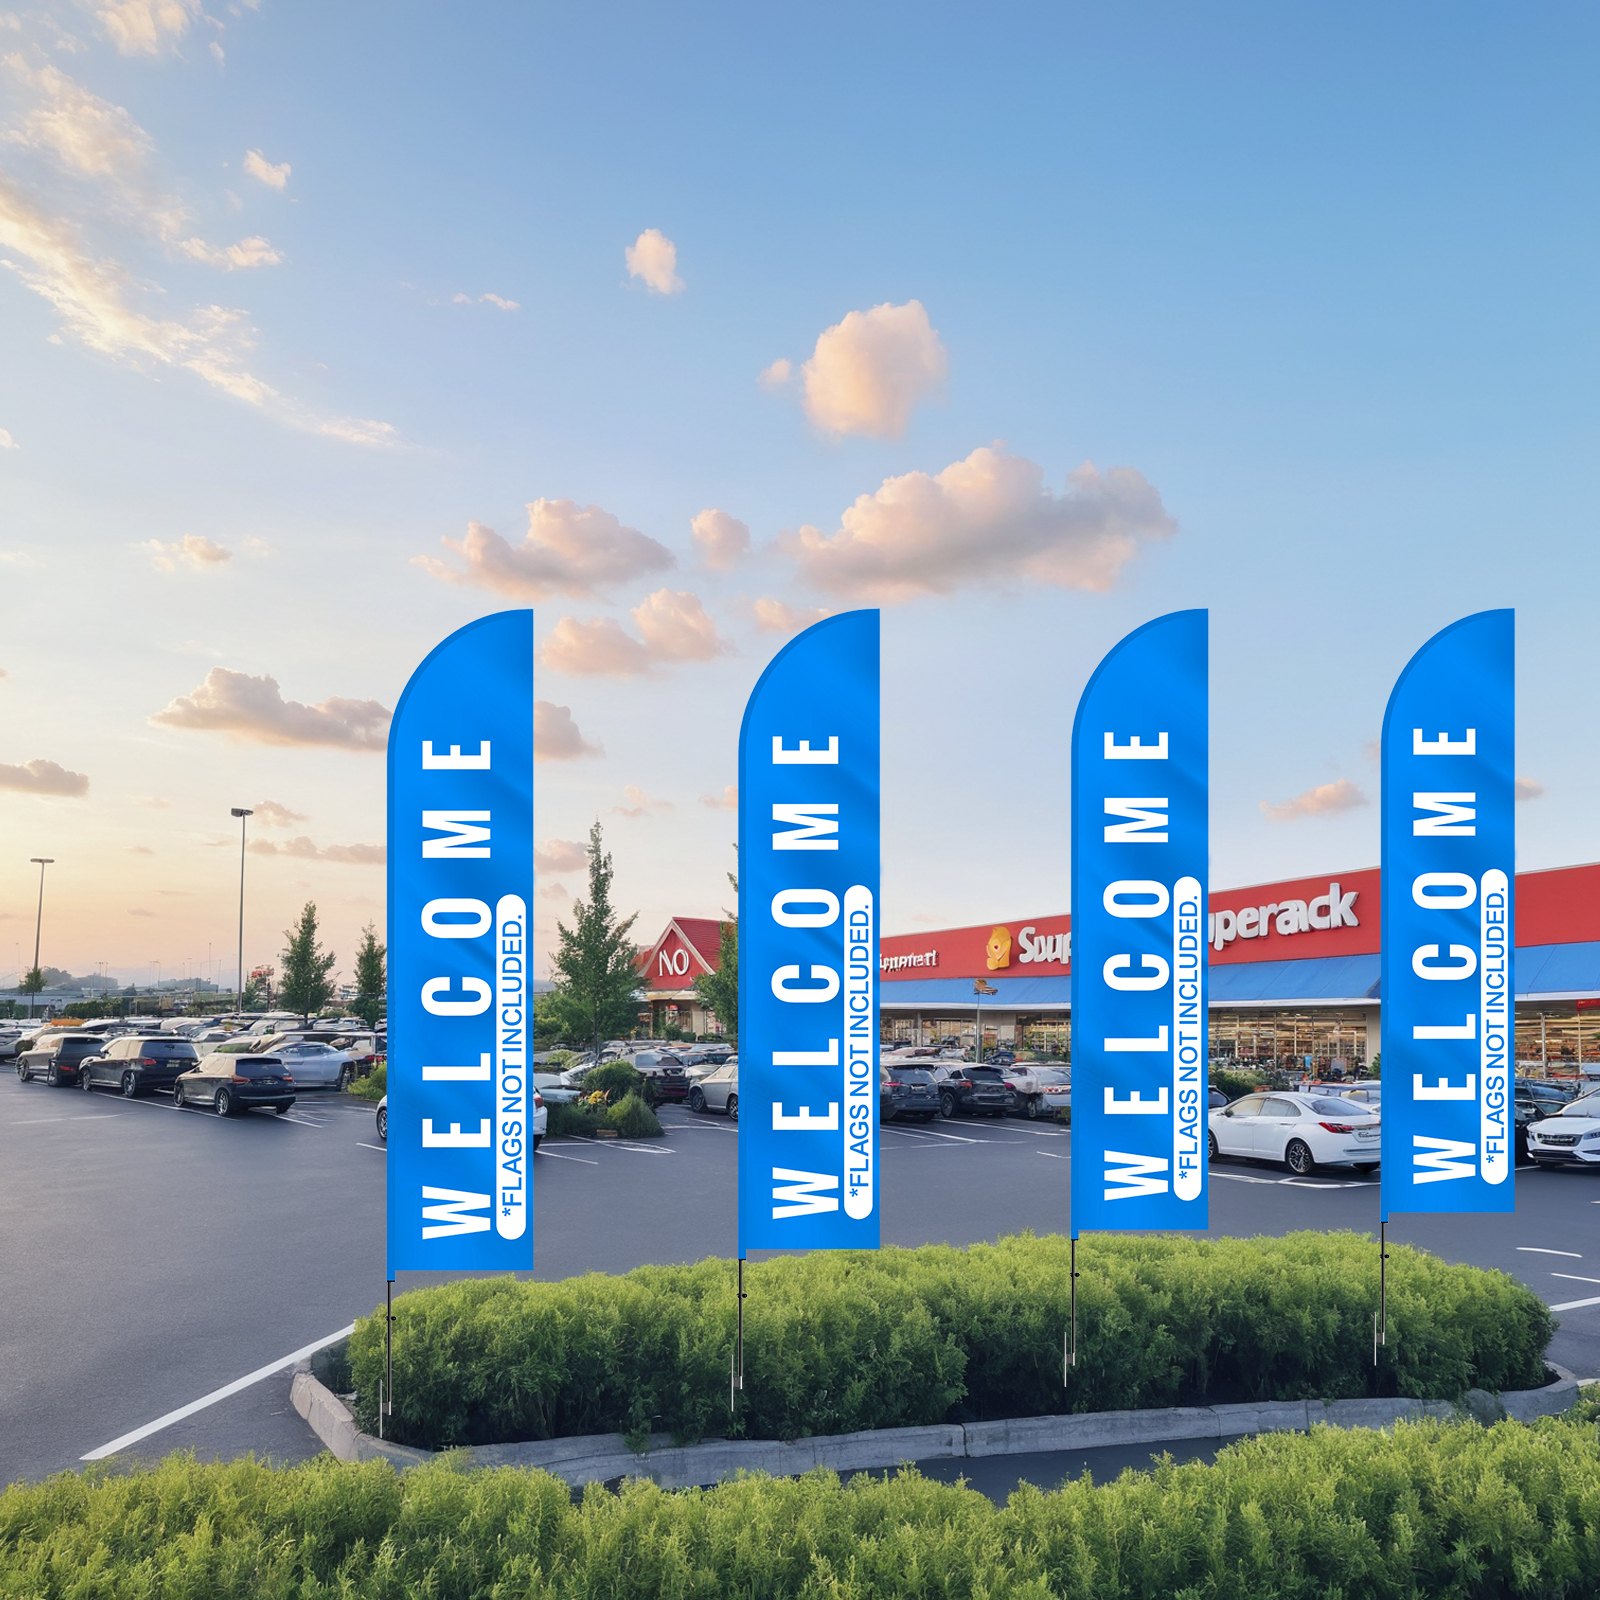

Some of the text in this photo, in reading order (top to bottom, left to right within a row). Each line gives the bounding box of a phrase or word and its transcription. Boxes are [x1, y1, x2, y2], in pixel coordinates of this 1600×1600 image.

[421, 741, 492, 1239] WELCOME
[502, 915, 522, 1051] INCLUDED.
[658, 948, 690, 977] NO
[772, 736, 839, 1219] WELCOME
[850, 906, 870, 1037] INCLUDED.
[1103, 732, 1169, 1200] WELCOME
[1179, 896, 1199, 1024] INCLUDED.
[1412, 729, 1477, 1184] WELCOME
[1486, 888, 1505, 1012] INCLUDED.
[502, 1059, 522, 1112] NOT
[850, 1045, 870, 1096] NOT
[1179, 1031, 1199, 1081] NOT
[1486, 1020, 1505, 1068] NOT
